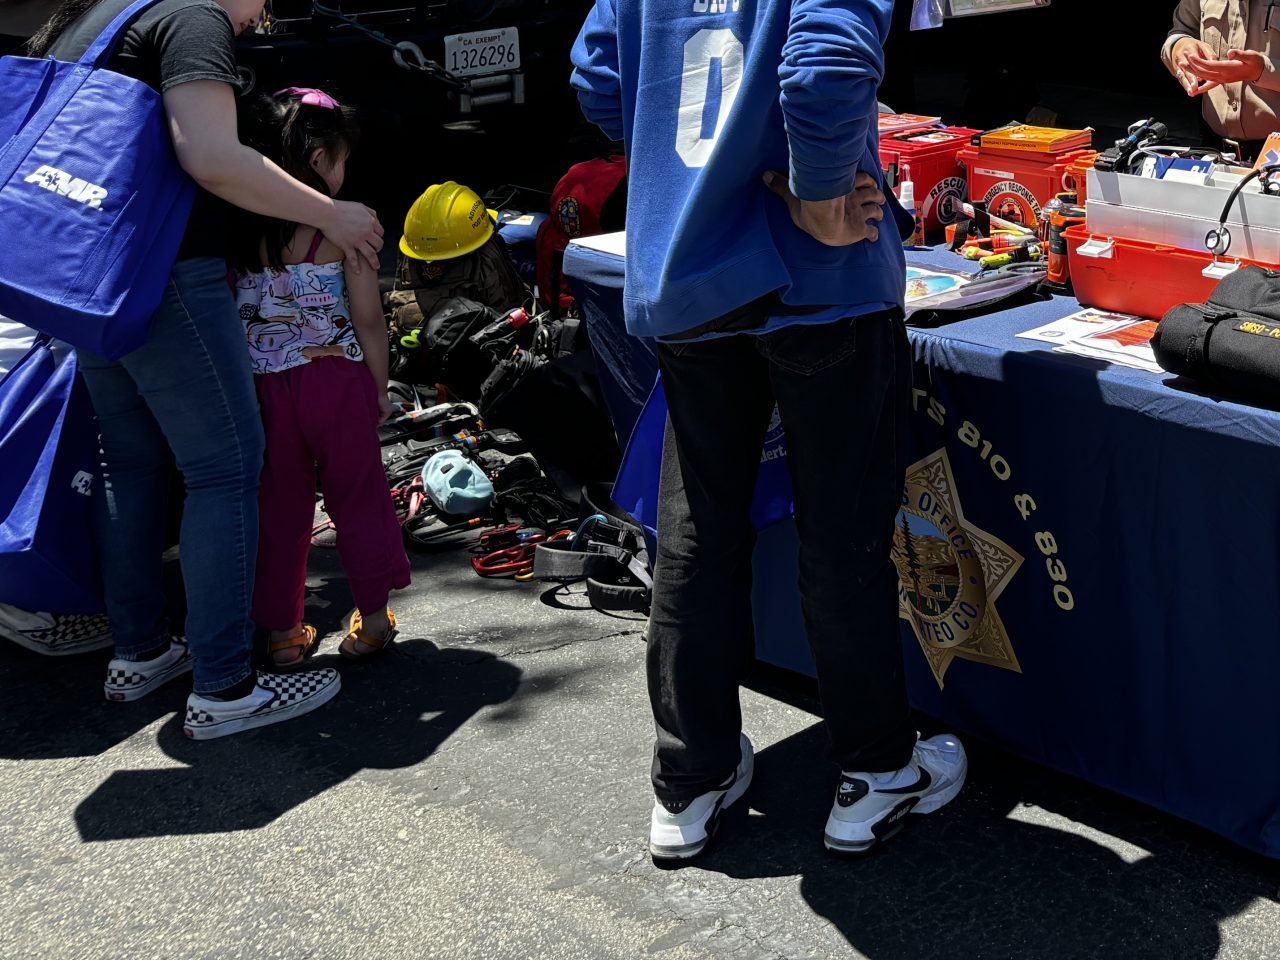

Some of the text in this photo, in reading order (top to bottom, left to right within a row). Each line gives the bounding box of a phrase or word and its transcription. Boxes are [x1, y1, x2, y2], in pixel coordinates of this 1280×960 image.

[475, 34, 502, 45] EXEMPT
[450, 43, 515, 71] 1326296
[23, 165, 108, 211] AMR
[929, 177, 966, 200] RESCU
[1008, 182, 1036, 206] RESPONSE
[918, 491, 974, 560] OFFICE
[957, 420, 1075, 611] 810 & 830
